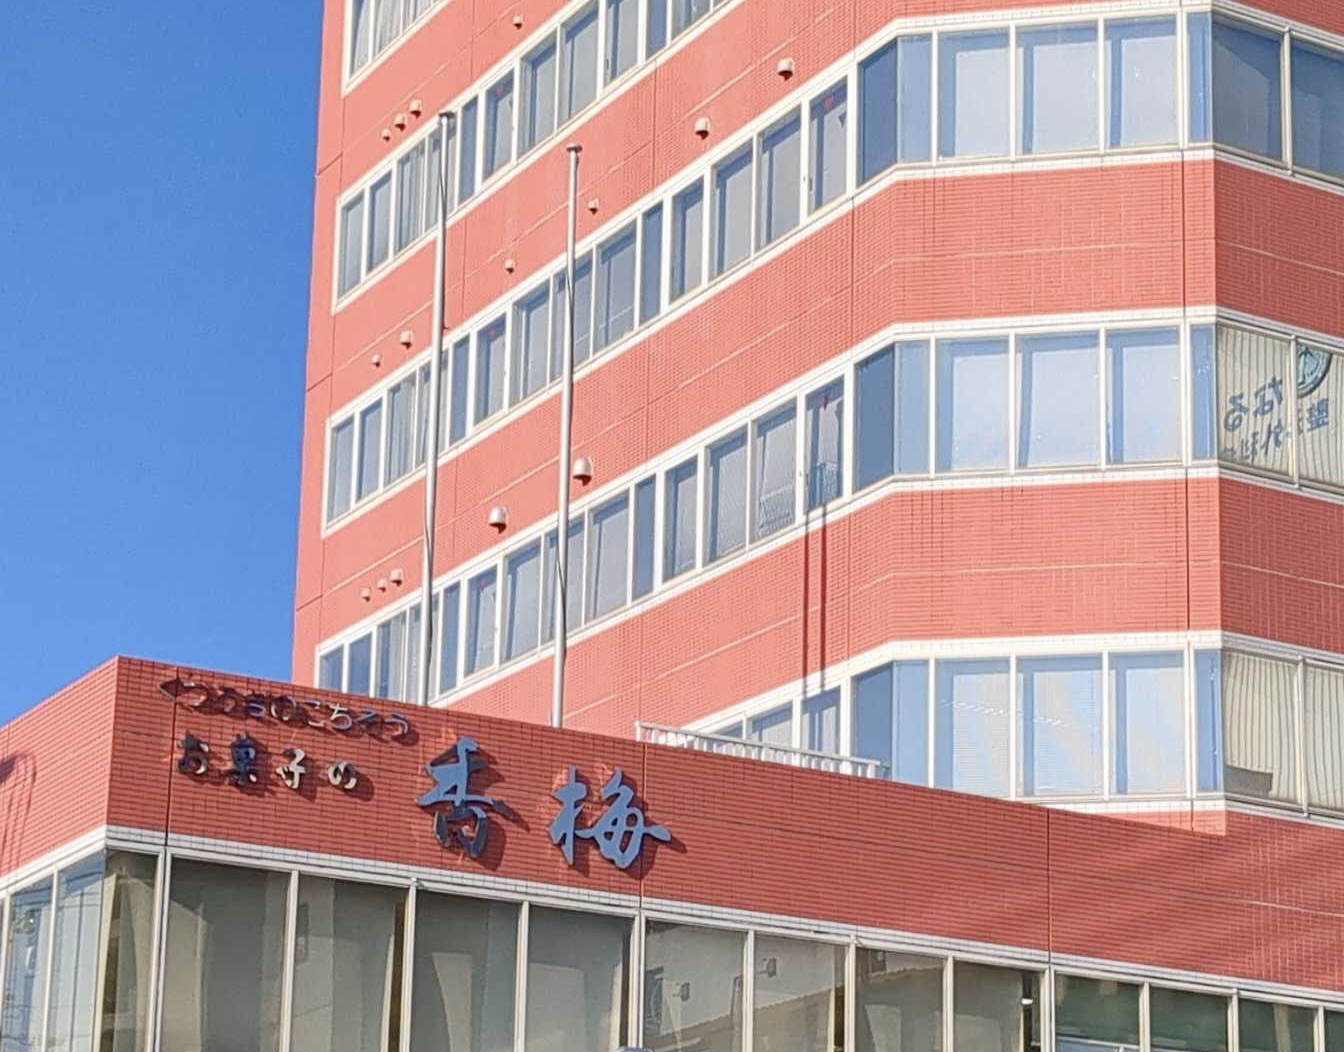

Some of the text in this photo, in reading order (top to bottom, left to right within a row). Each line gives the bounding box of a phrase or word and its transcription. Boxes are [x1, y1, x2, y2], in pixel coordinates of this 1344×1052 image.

[178, 730, 672, 869] お菓子の 香梅
